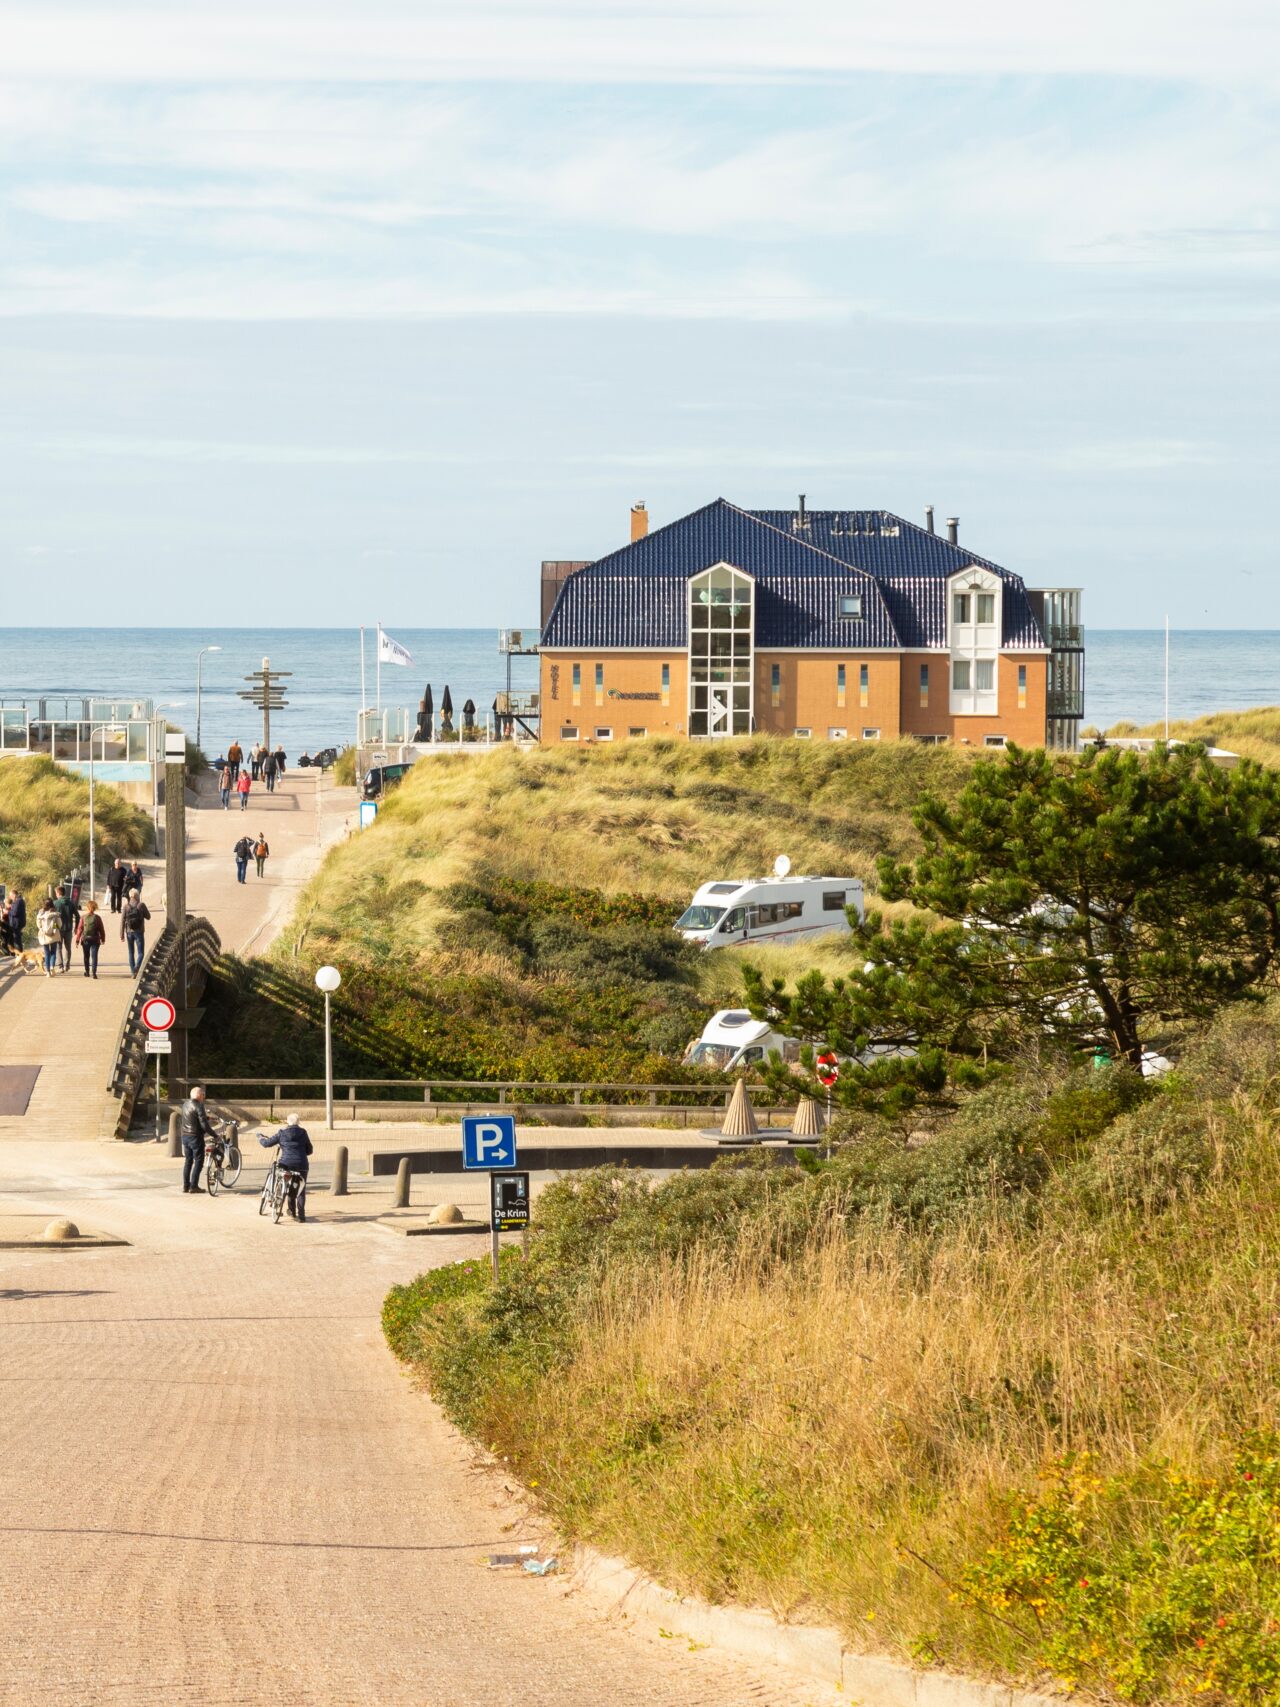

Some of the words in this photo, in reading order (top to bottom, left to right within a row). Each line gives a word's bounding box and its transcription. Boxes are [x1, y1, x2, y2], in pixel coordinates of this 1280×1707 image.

[475, 1123, 503, 1162] P
[494, 1209, 506, 1218] De
[507, 1208, 527, 1218] Krim
